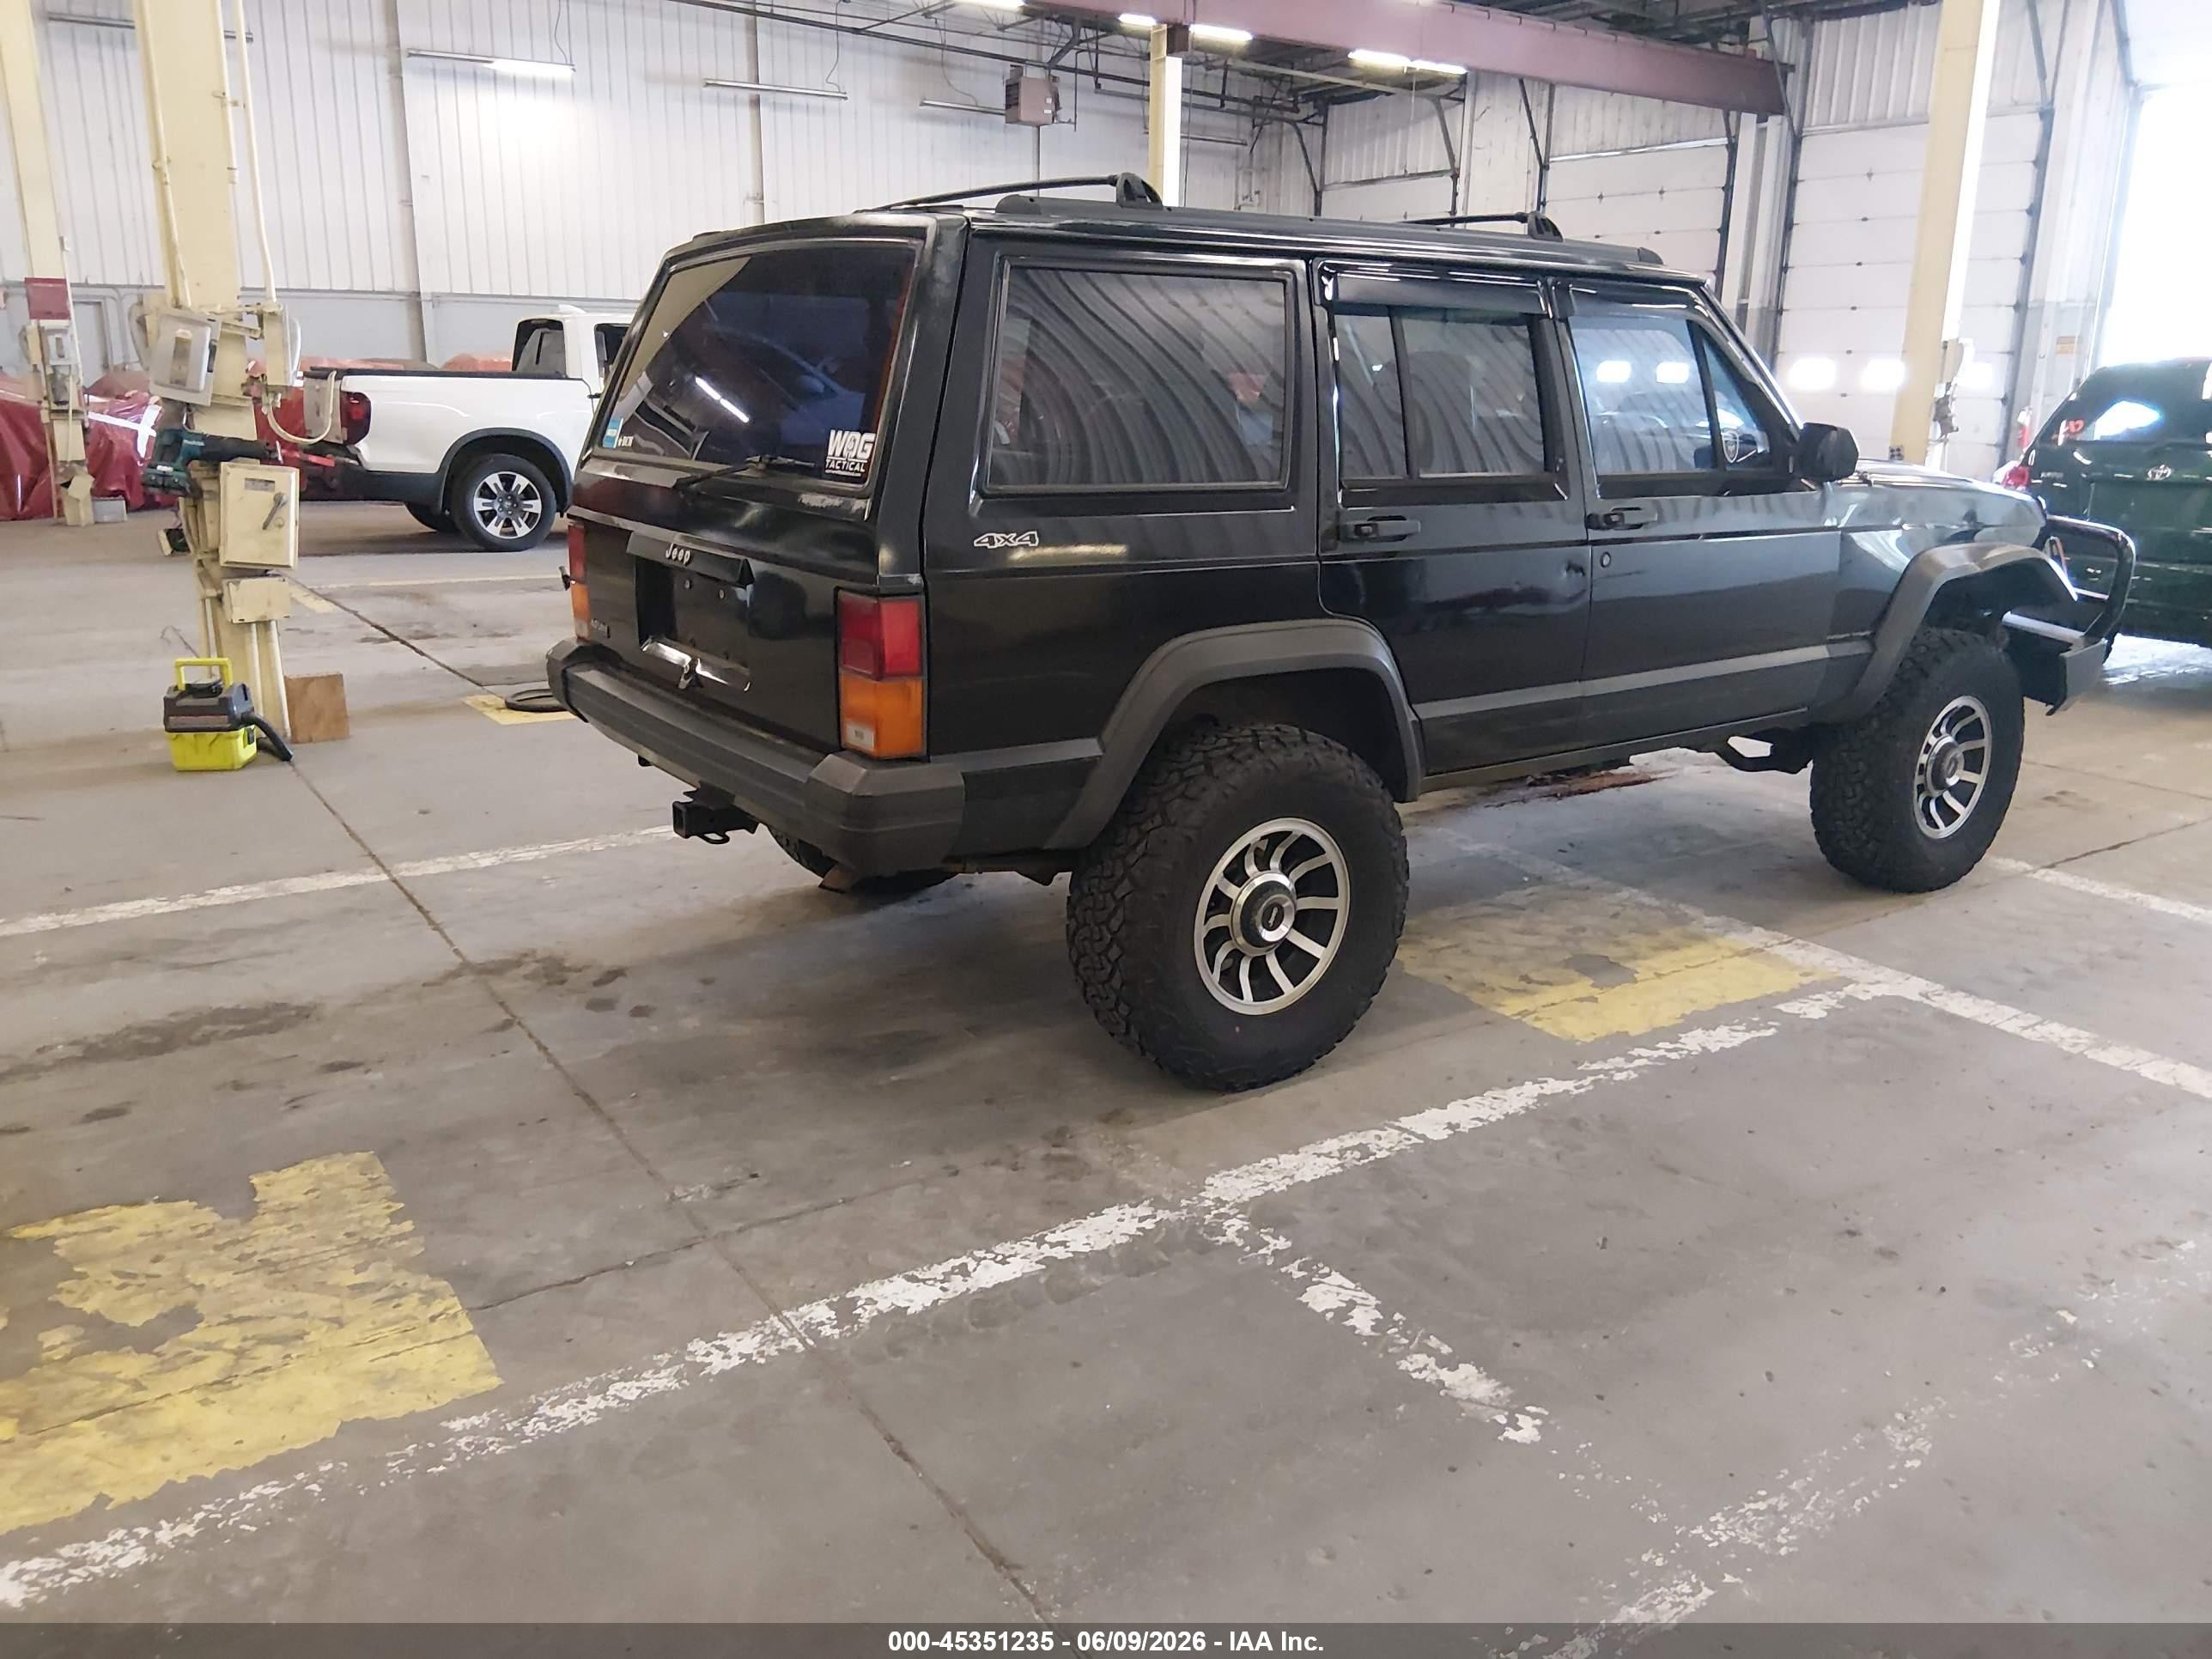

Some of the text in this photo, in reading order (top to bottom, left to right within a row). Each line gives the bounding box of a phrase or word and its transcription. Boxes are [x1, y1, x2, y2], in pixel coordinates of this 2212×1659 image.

[828, 429, 876, 459] WOG
[825, 459, 866, 472] TACTICAL
[665, 543, 691, 566] Jeep
